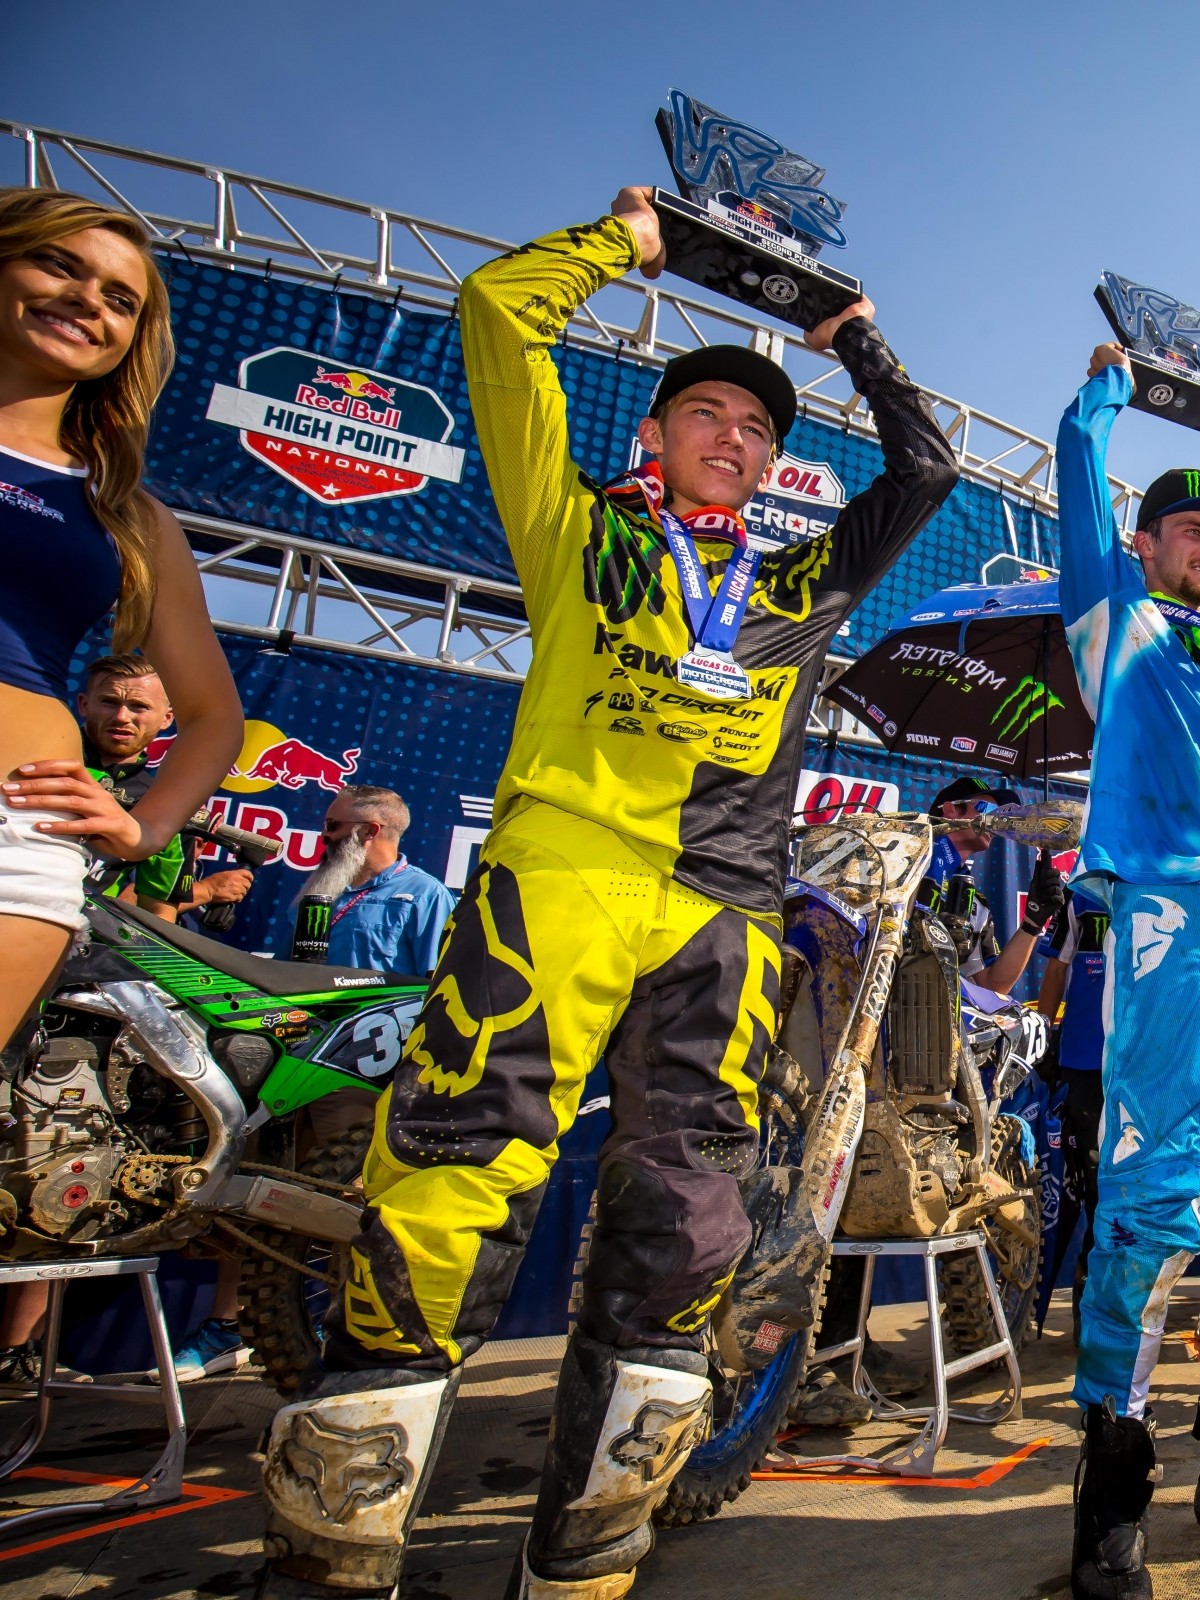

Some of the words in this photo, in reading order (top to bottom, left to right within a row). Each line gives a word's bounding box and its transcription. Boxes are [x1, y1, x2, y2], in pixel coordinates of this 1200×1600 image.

[728, 211, 752, 229] HIGH
[754, 224, 785, 243] POINT
[761, 238, 793, 257] SECOND
[794, 252, 819, 269] PLACE
[295, 384, 348, 415] Red
[350, 400, 401, 429] Bull
[263, 406, 332, 442] HIGH
[336, 422, 417, 463] POINT
[265, 440, 405, 483] NATIONAL
[290, 465, 376, 490] PENNSYLVANIA
[778, 466, 822, 497] OIL
[674, 534, 703, 600] MOTOCROSS
[727, 573, 750, 603] LUCAS
[720, 603, 737, 627] 2018
[593, 622, 788, 702] Kawki
[690, 657, 720, 671] LUCAS
[722, 665, 737, 675] OIL
[681, 668, 746, 687] MOTOCROSS
[659, 693, 764, 722] CIRCUIT
[718, 726, 760, 739] DUNLOP
[723, 741, 762, 752] SCOTT
[333, 976, 386, 988] Kawasaki
[1022, 1011, 1047, 1064] 23
[840, 1098, 865, 1150] YAMALUBE
[754, 1335, 779, 1352] SPEED
[760, 1323, 786, 1339] LIGHT
